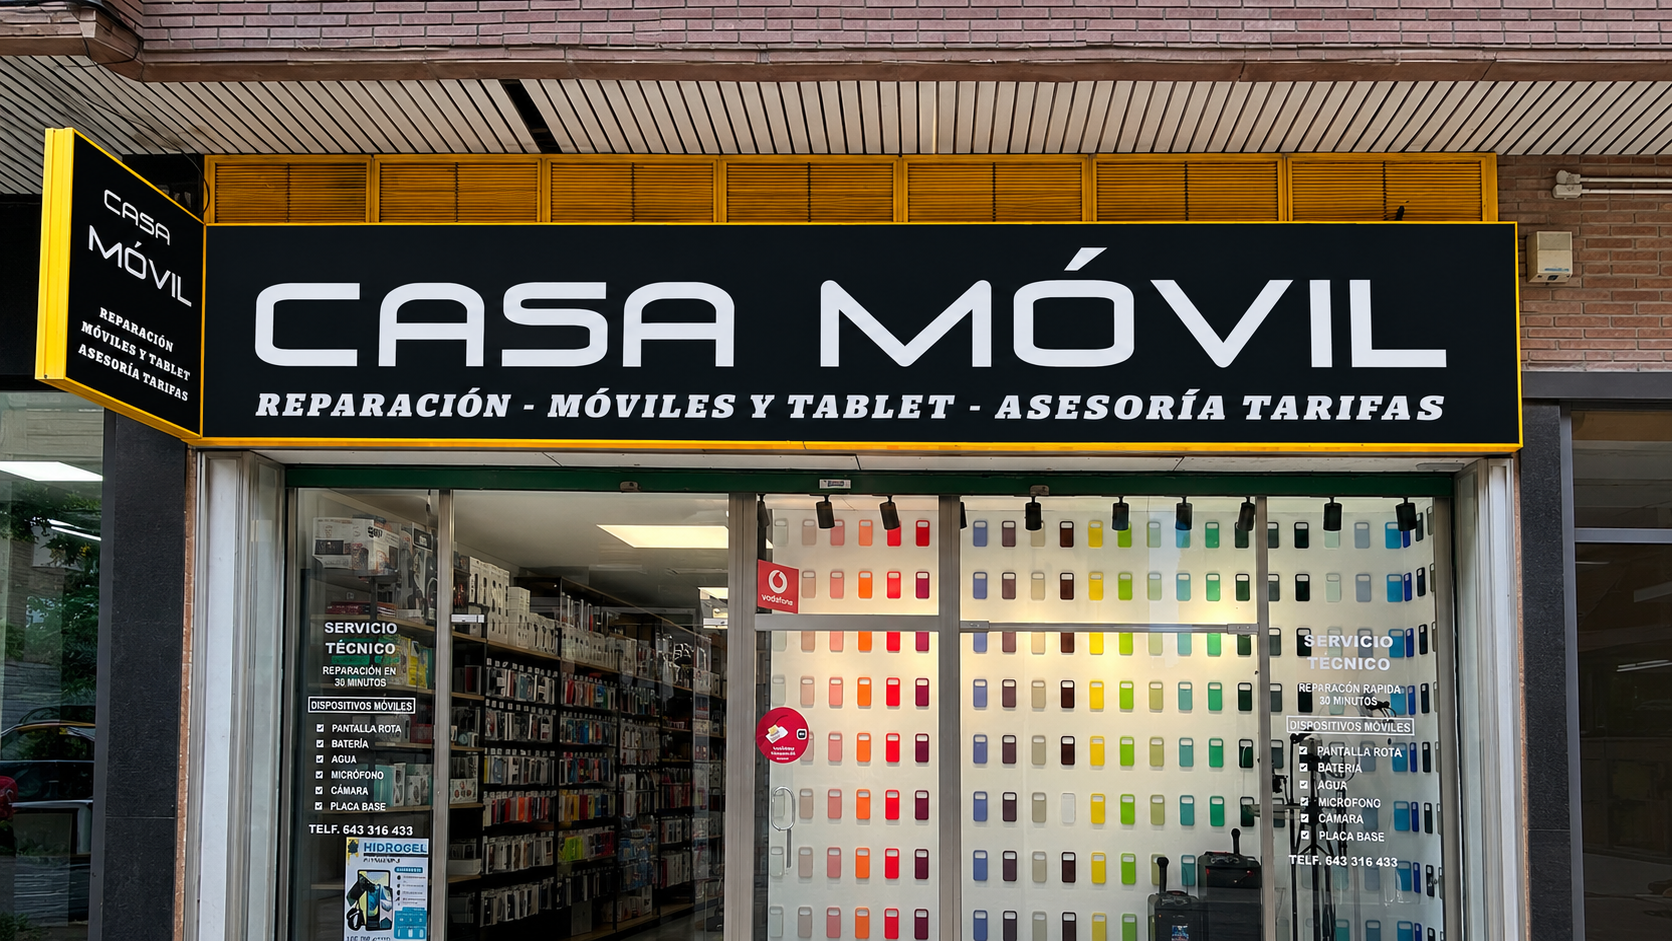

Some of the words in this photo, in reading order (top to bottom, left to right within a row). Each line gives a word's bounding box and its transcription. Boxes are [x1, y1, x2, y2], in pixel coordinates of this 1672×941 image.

[104, 189, 170, 246] CASA
[88, 224, 192, 307] MÓVIL
[255, 281, 735, 367] CASA
[820, 247, 1447, 369] MÓVIL
[99, 307, 174, 352] REPARACIÓN
[81, 321, 137, 356] MÓVILES
[139, 348, 147, 361] Y
[148, 353, 191, 381] TABLET
[78, 344, 140, 380] ASESORÍA
[142, 372, 189, 402] TARIFAS
[255, 387, 512, 418] REPARACIÓN
[547, 387, 736, 419] MÓVILES
[750, 394, 776, 419] Y
[787, 394, 956, 419] TABLET
[994, 388, 1226, 420] ASESORÍA
[1242, 395, 1445, 421] TARIFAS
[324, 622, 398, 634] SERVICIO
[325, 639, 396, 655] TÉCNICO
[1304, 635, 1394, 648] SERVICIO
[1306, 652, 1391, 671] TÉCNICO
[322, 665, 382, 676] REPARACIÓN
[384, 667, 397, 676] EN
[334, 678, 346, 687] 30
[347, 678, 387, 687] MINUTOS
[1363, 683, 1402, 694] RAPIDA
[311, 701, 372, 710] DISPOSITIVOS
[373, 700, 413, 711] MÓVILES
[1319, 696, 1331, 706] 30
[1333, 696, 1378, 706] MINUTOS
[331, 724, 377, 733] PANTALLA
[378, 725, 402, 733] ROTA
[1289, 720, 1362, 732] DISPOSITIVOS
[331, 738, 369, 749] BATERÍA
[1316, 746, 1371, 757] PANTALLA
[1373, 747, 1403, 758] ROTA
[331, 755, 357, 763] AGUA
[331, 769, 384, 780] MICRÓFONO
[330, 784, 369, 796] CÁMARA
[1317, 780, 1348, 791] AGUA
[330, 802, 360, 811] PLACA
[361, 803, 386, 811] BASE
[308, 824, 340, 834] TELF.
[342, 825, 364, 835] 643
[367, 826, 389, 836] 316
[391, 826, 413, 836] 433
[1318, 830, 1354, 841] PLACA
[1356, 831, 1385, 843] BASE
[363, 842, 427, 853] HIDROGEL
[1288, 854, 1322, 866] TELF.
[1325, 855, 1348, 867] 643
[1350, 856, 1374, 867] 316
[1375, 857, 1399, 868] 433
